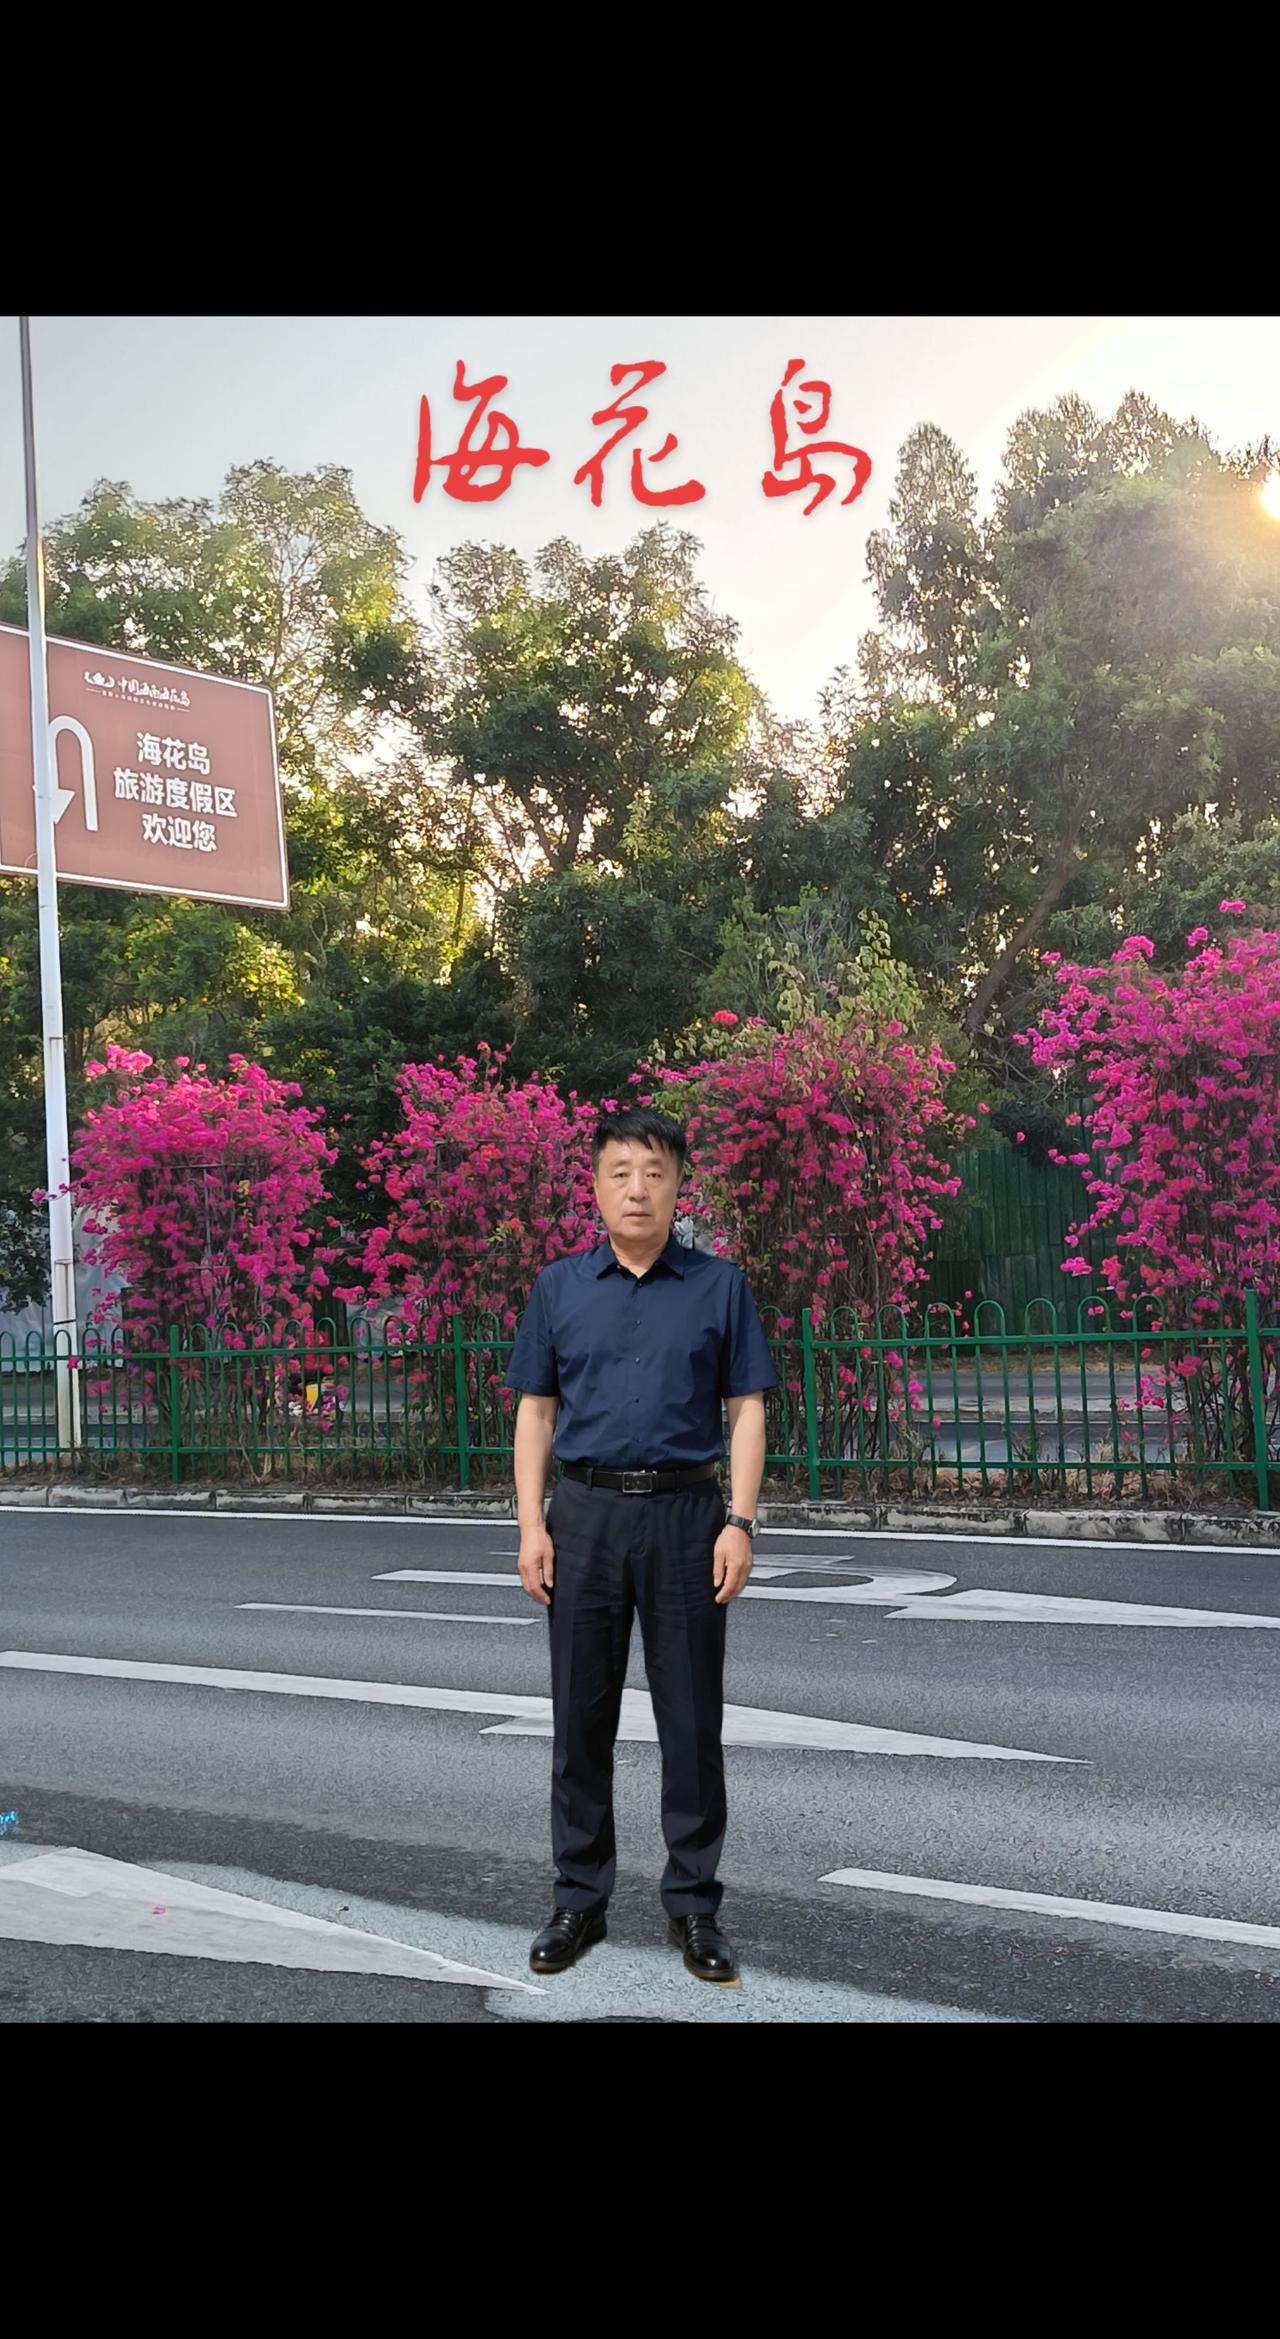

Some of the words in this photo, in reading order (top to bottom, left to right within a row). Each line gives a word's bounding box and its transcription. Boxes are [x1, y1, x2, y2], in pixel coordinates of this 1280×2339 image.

[136, 732, 211, 775] 海花岛
[113, 767, 238, 817] 旅游度假区
[142, 813, 217, 852] 欢迎您
